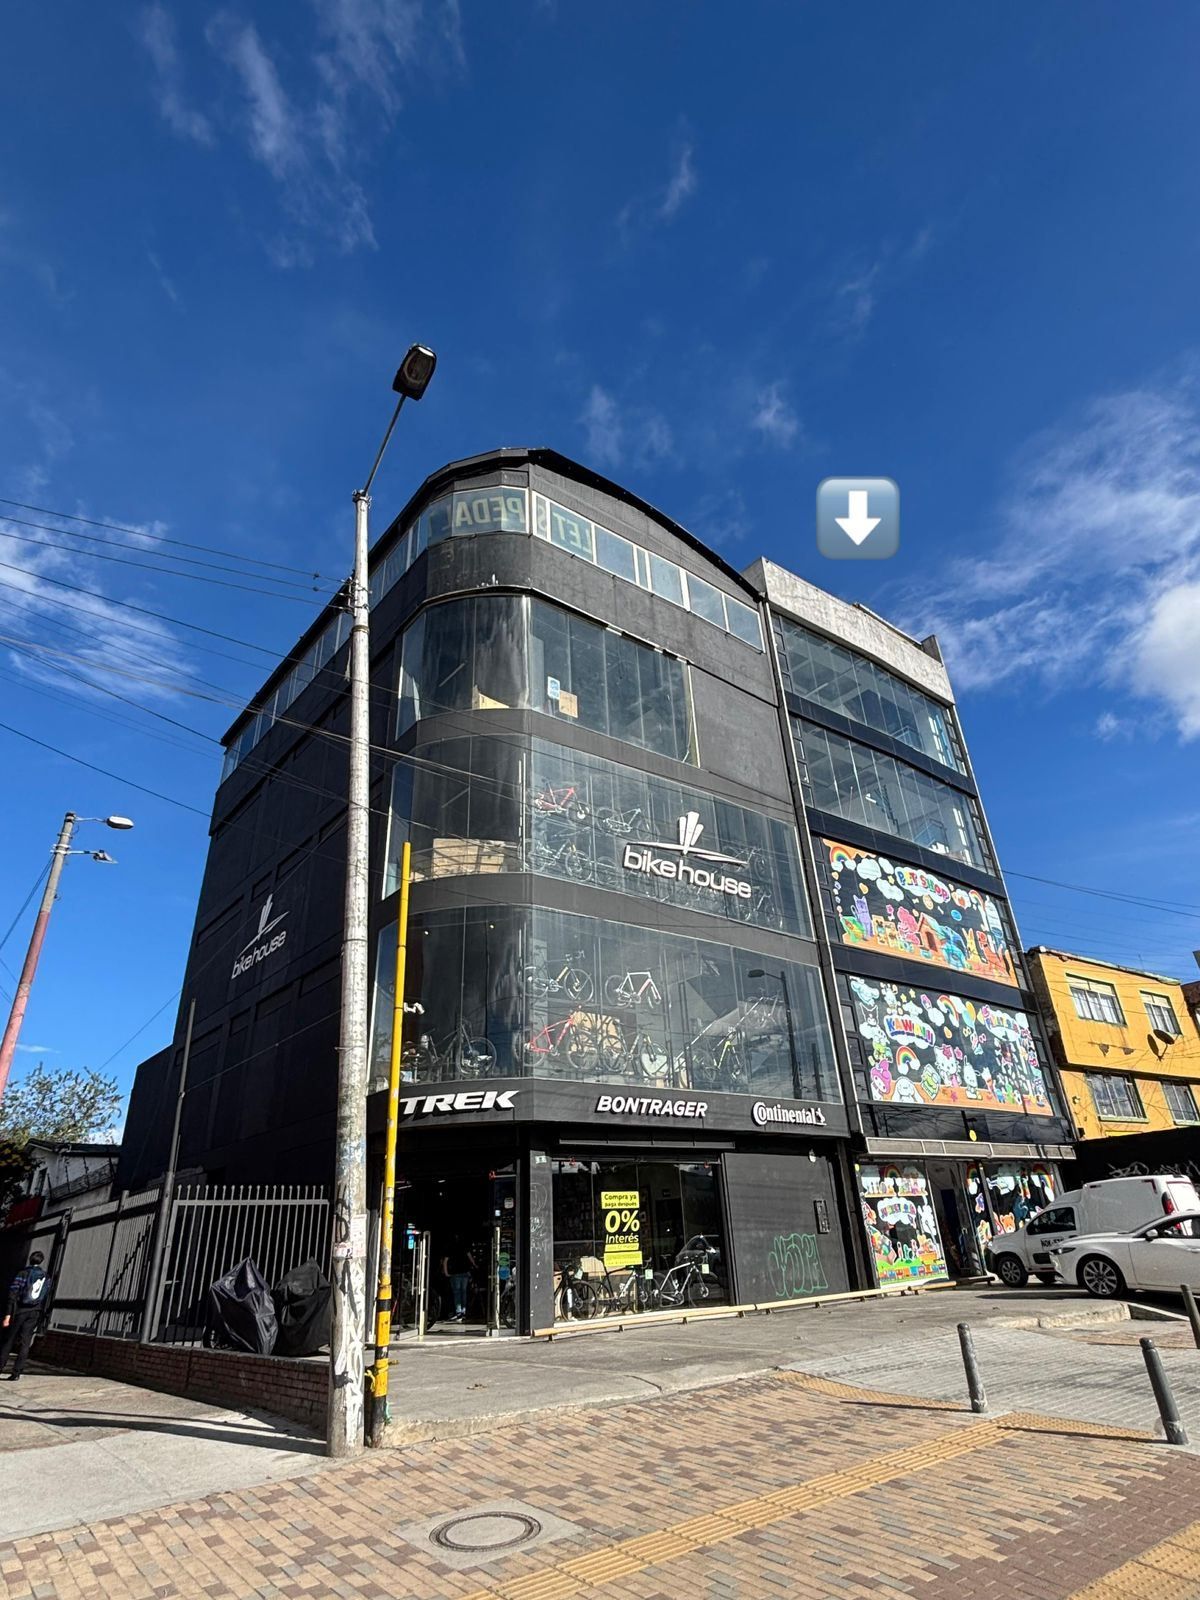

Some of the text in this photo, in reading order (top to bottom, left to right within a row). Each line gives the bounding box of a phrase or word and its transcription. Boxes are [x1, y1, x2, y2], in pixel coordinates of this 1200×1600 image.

[623, 844, 752, 899] bikehouse
[898, 870, 949, 901] PET SHOP
[231, 930, 287, 980] bikehouse
[399, 1090, 520, 1115] TREK
[597, 1095, 708, 1117] BONTRAGER
[752, 1101, 818, 1126] Continental
[604, 1193, 628, 1201] Compra
[605, 1209, 640, 1233] 0%
[605, 1232, 639, 1244] Interés
